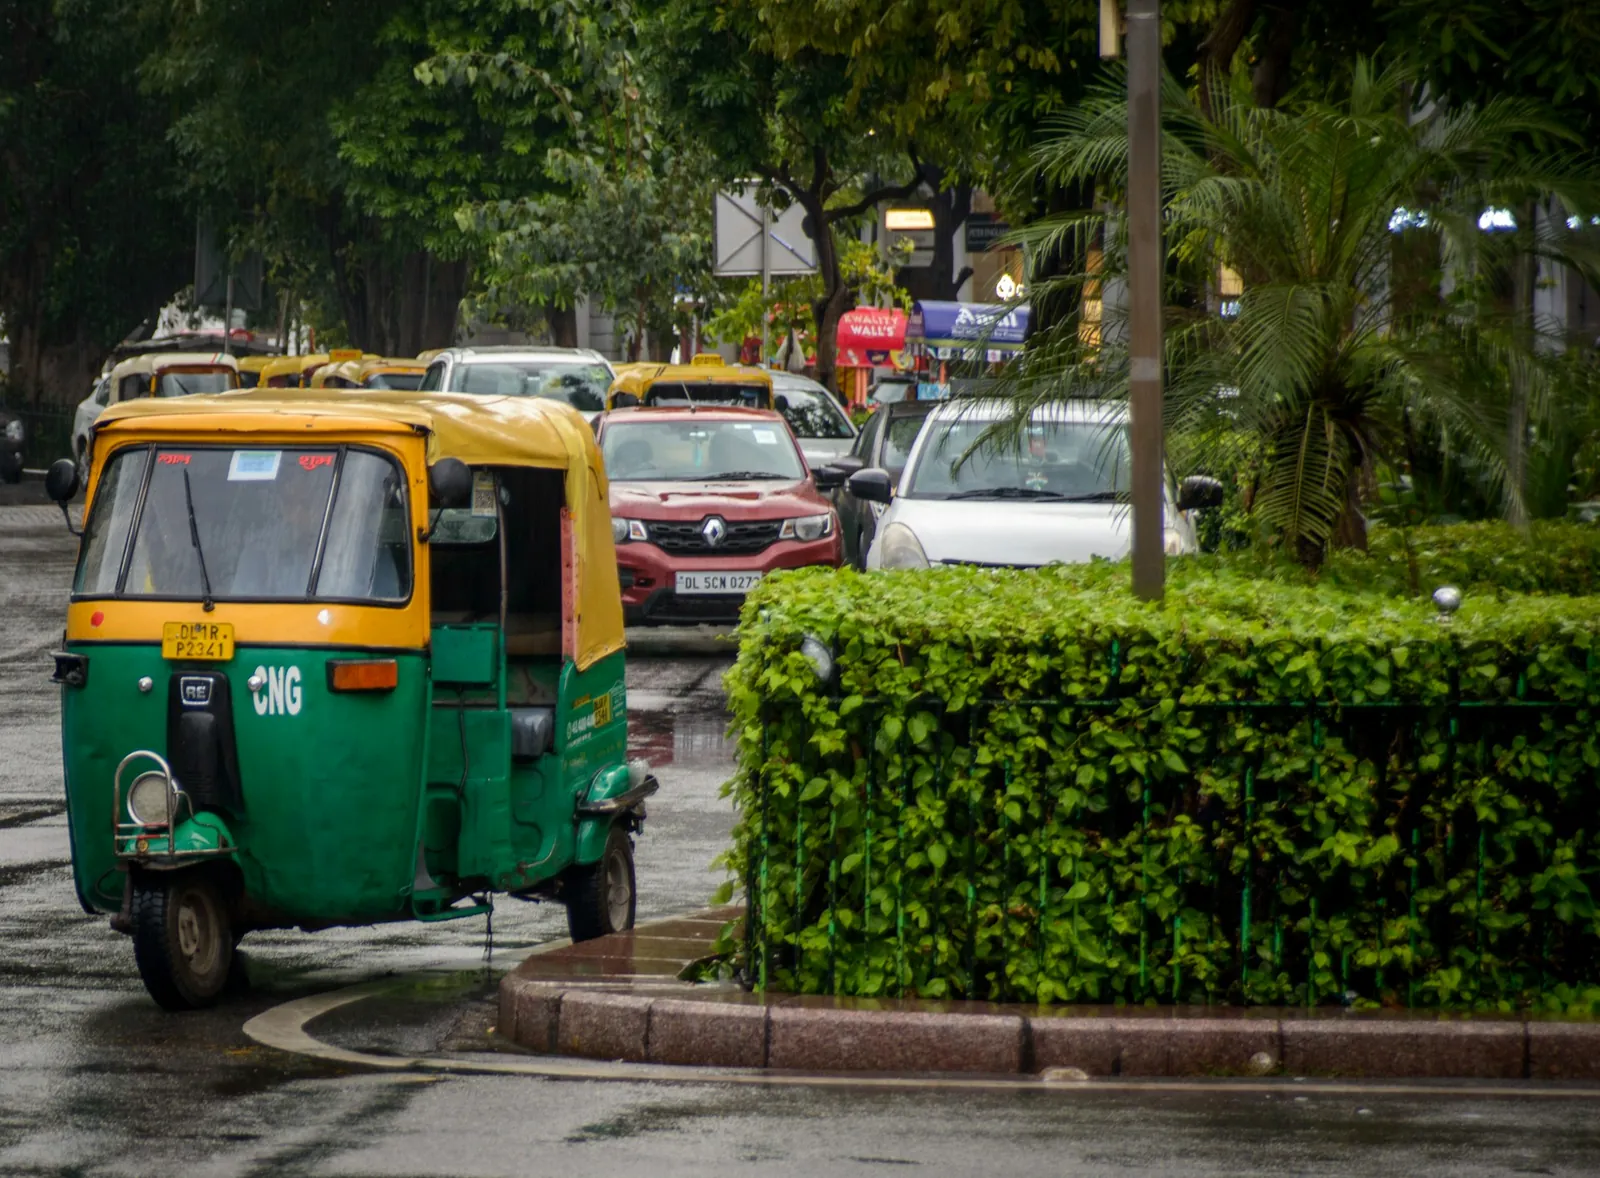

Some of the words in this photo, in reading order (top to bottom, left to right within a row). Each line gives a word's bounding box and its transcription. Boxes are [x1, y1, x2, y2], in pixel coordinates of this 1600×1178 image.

[843, 313, 899, 325] KWALITY
[850, 324, 896, 337] WALL'S
[685, 576, 699, 590] DL
[704, 576, 727, 589] 5CN
[180, 624, 219, 640] DL1R
[176, 642, 224, 657] P2341
[185, 685, 206, 699] RE
[253, 665, 302, 716] CNG
